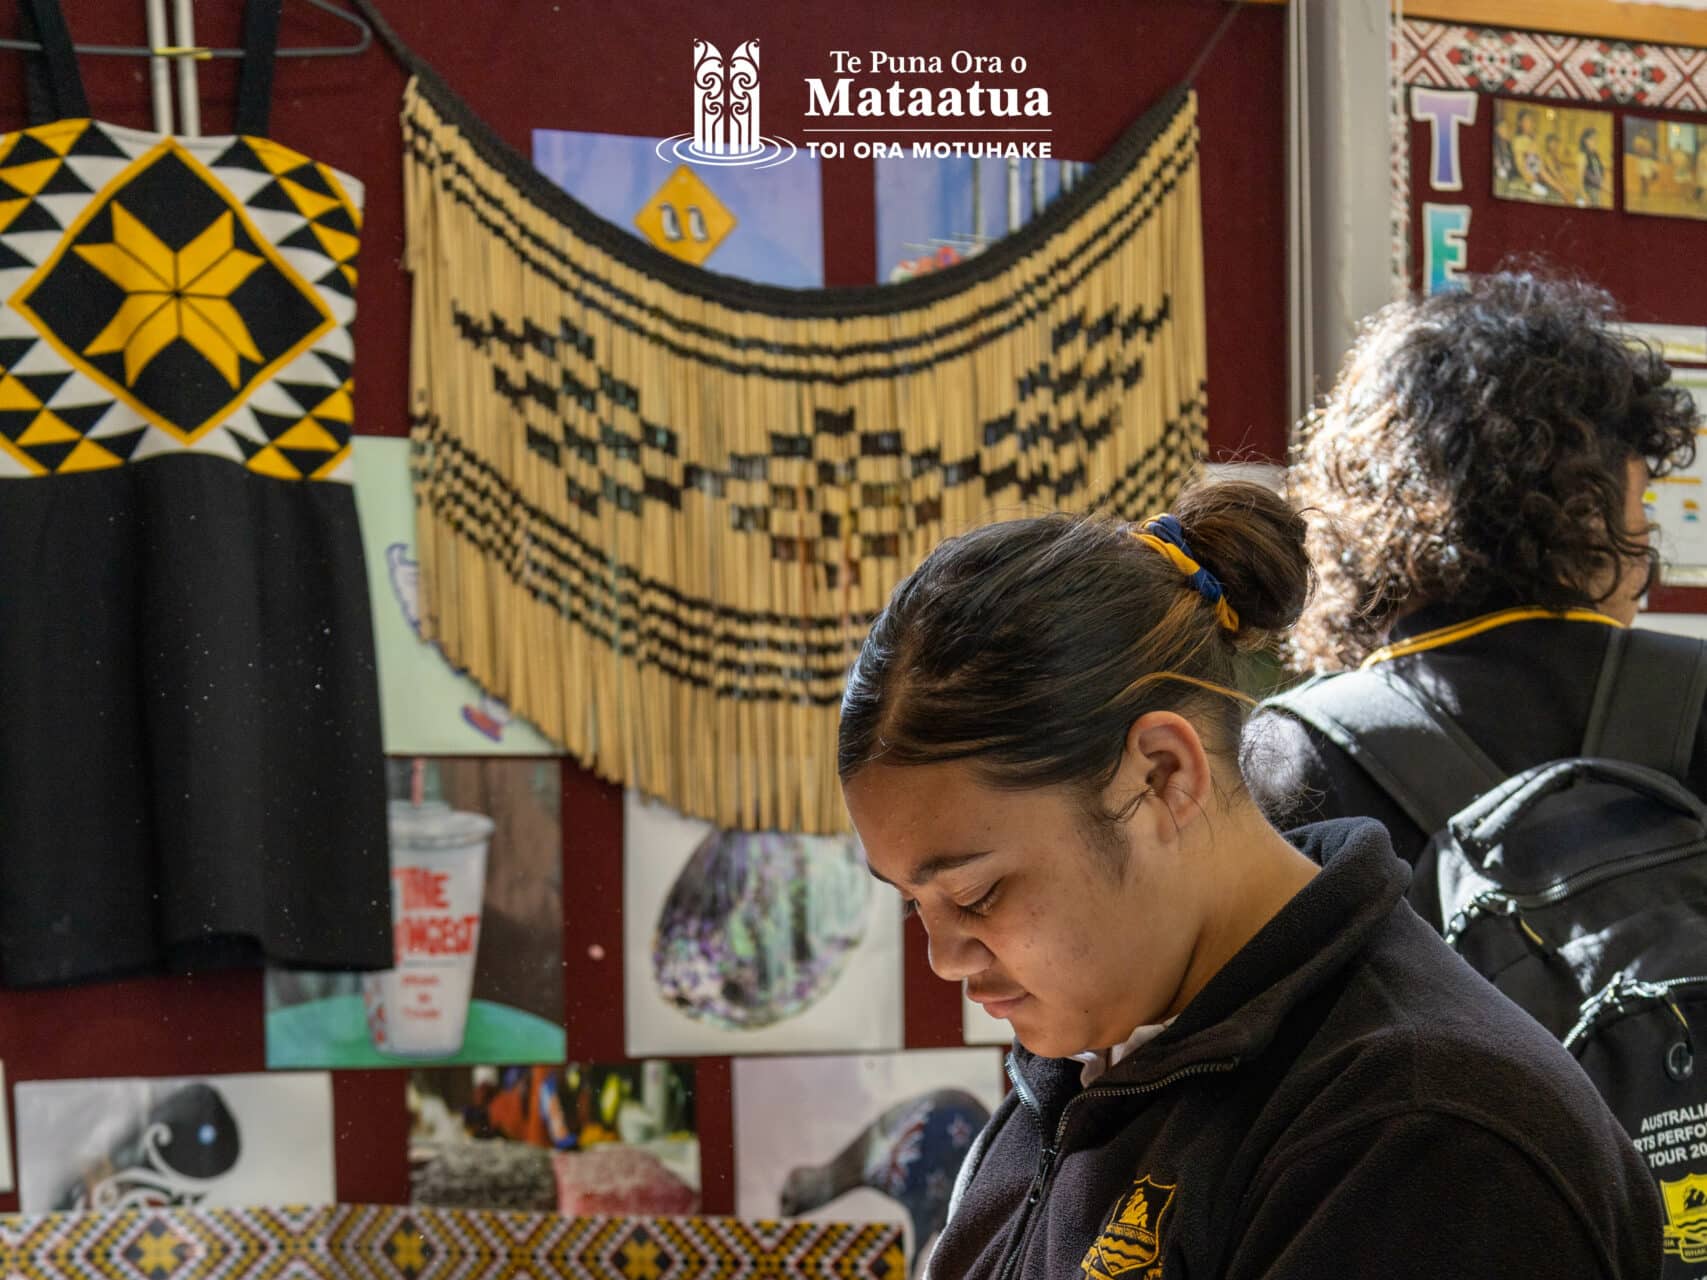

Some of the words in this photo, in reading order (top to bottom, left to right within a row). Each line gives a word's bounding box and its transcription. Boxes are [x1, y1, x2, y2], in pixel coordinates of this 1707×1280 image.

[1633, 1135, 1656, 1152] RTS
[1657, 1122, 1707, 1147] PERFO
[1649, 1147, 1688, 1168] TOUR
[1689, 1142, 1707, 1159] 20
